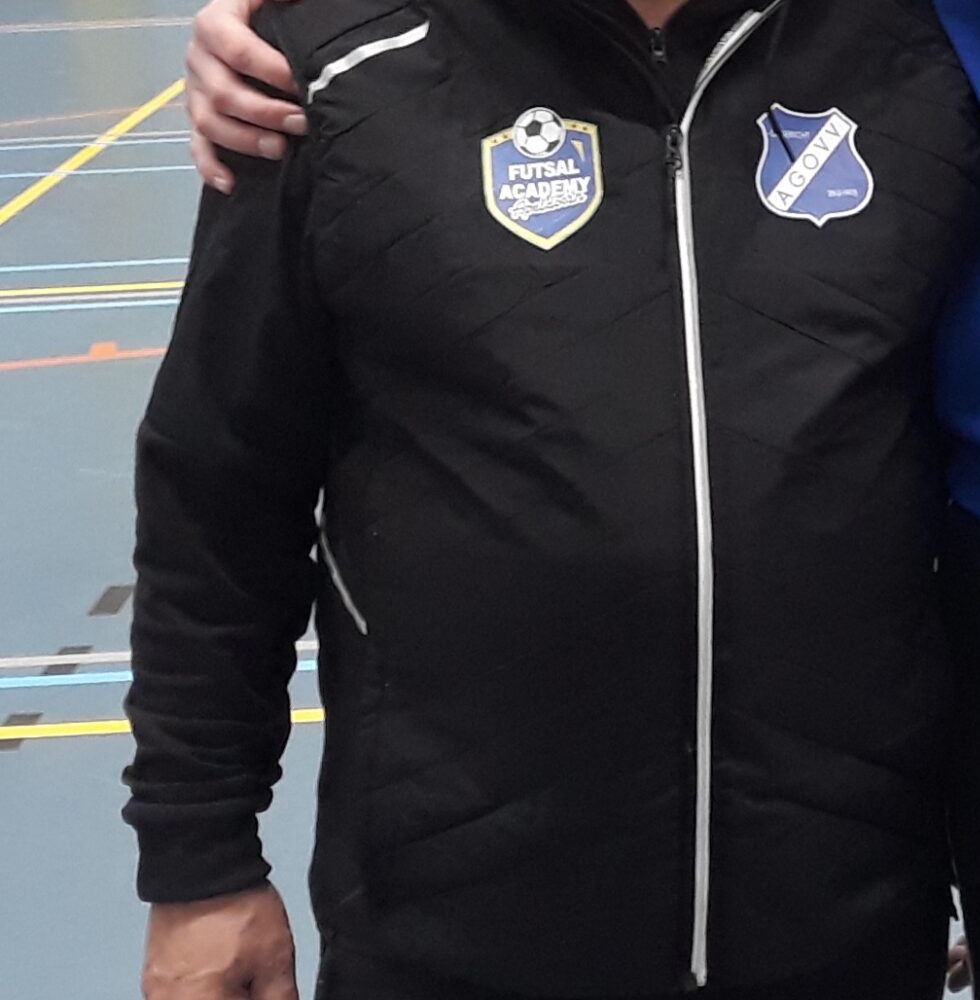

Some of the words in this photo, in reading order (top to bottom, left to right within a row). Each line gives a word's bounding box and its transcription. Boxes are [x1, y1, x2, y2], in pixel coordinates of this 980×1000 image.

[508, 158, 581, 181] FUTSAL
[776, 121, 841, 206] AGOVV
[499, 176, 591, 201] ACADEMY
